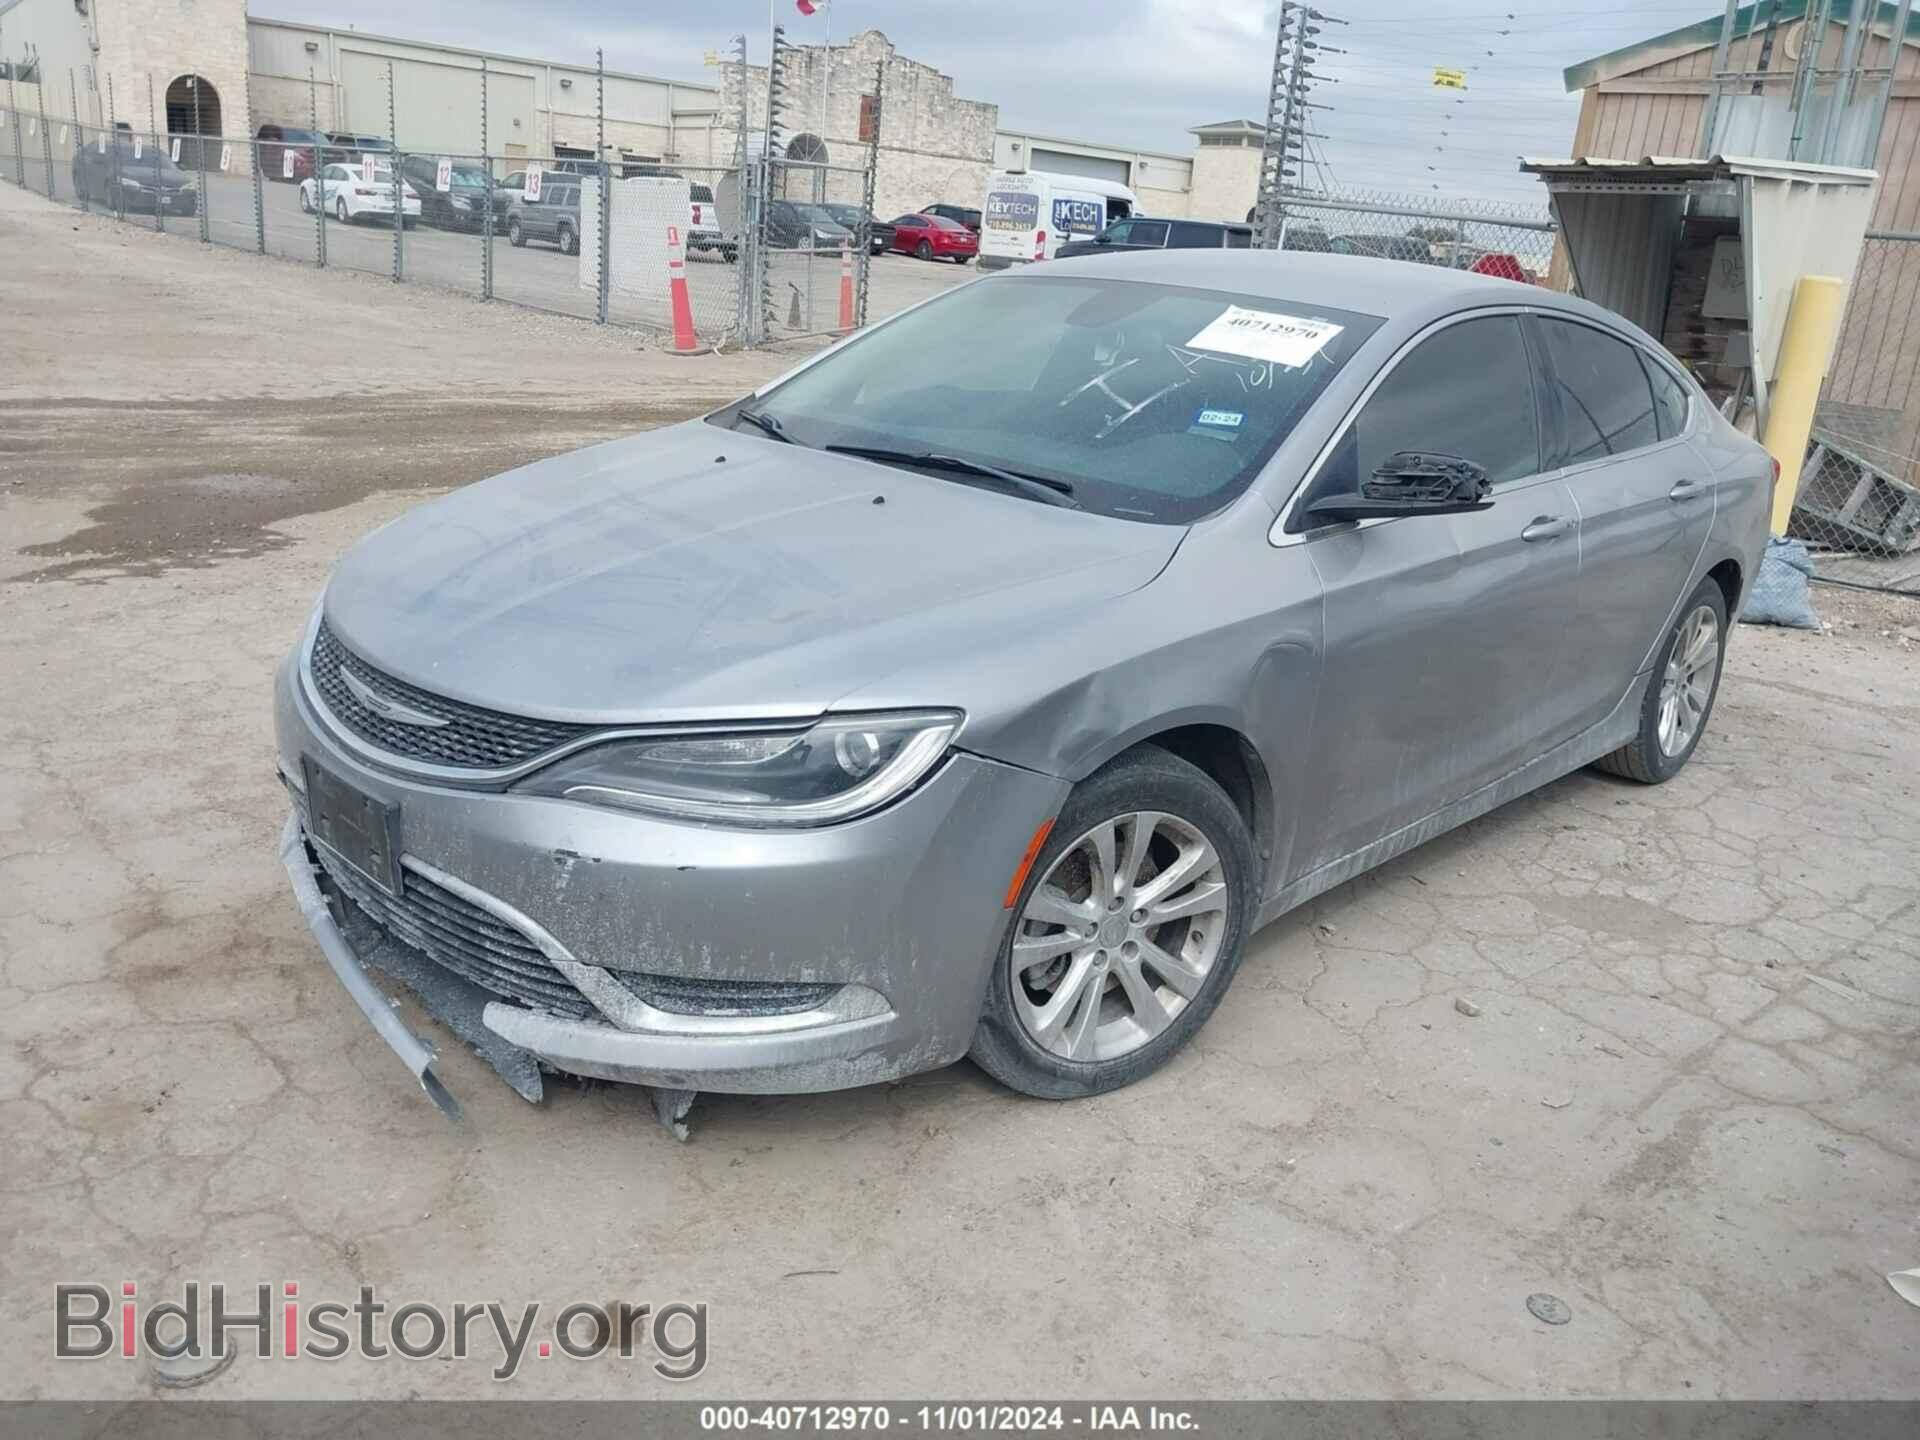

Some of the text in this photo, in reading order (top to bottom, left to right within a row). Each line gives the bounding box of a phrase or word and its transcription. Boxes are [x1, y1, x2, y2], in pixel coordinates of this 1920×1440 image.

[363, 161, 373, 180] 11
[439, 167, 450, 185] 12
[528, 174, 539, 194] 13
[988, 202, 1037, 216] KEYTECH
[1227, 317, 1319, 341] 40712970
